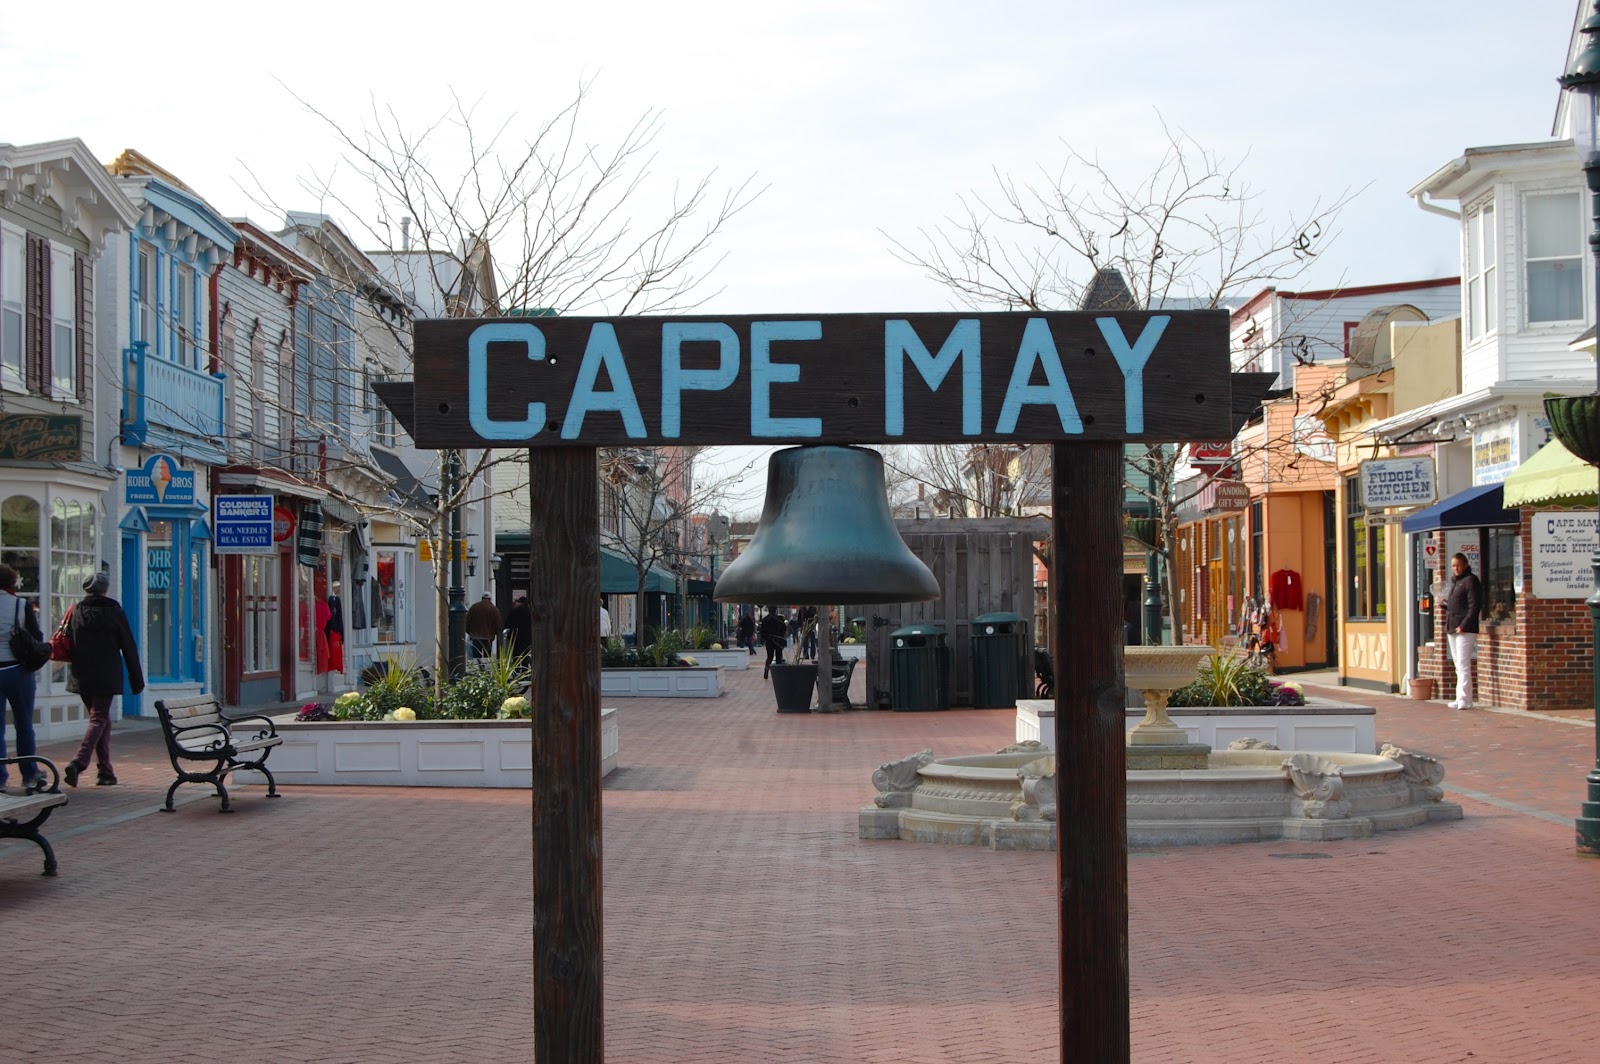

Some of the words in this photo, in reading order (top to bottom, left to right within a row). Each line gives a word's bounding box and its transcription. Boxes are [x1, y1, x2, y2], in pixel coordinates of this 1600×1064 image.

[469, 321, 822, 440] CAPE
[885, 315, 1170, 436] MAY
[127, 475, 150, 487] KOHR
[171, 476, 193, 488] BROS
[1369, 470, 1413, 484] FUDGE
[1218, 486, 1248, 496] PANDORA
[1368, 481, 1430, 496] KITCHEN
[1218, 498, 1232, 508] GIFT
[1233, 498, 1249, 508] SHOP
[219, 508, 260, 517] BANKER
[220, 526, 235, 534] SOL
[237, 526, 268, 534] NEEDLES
[1547, 519, 1575, 535] CAPE
[1566, 536, 1593, 544] Original
[1539, 543, 1567, 553] FUDGE
[148, 549, 172, 568] OHR
[1540, 560, 1573, 568] Welcomes
[148, 570, 171, 589] ROS
[1546, 575, 1571, 583] special
